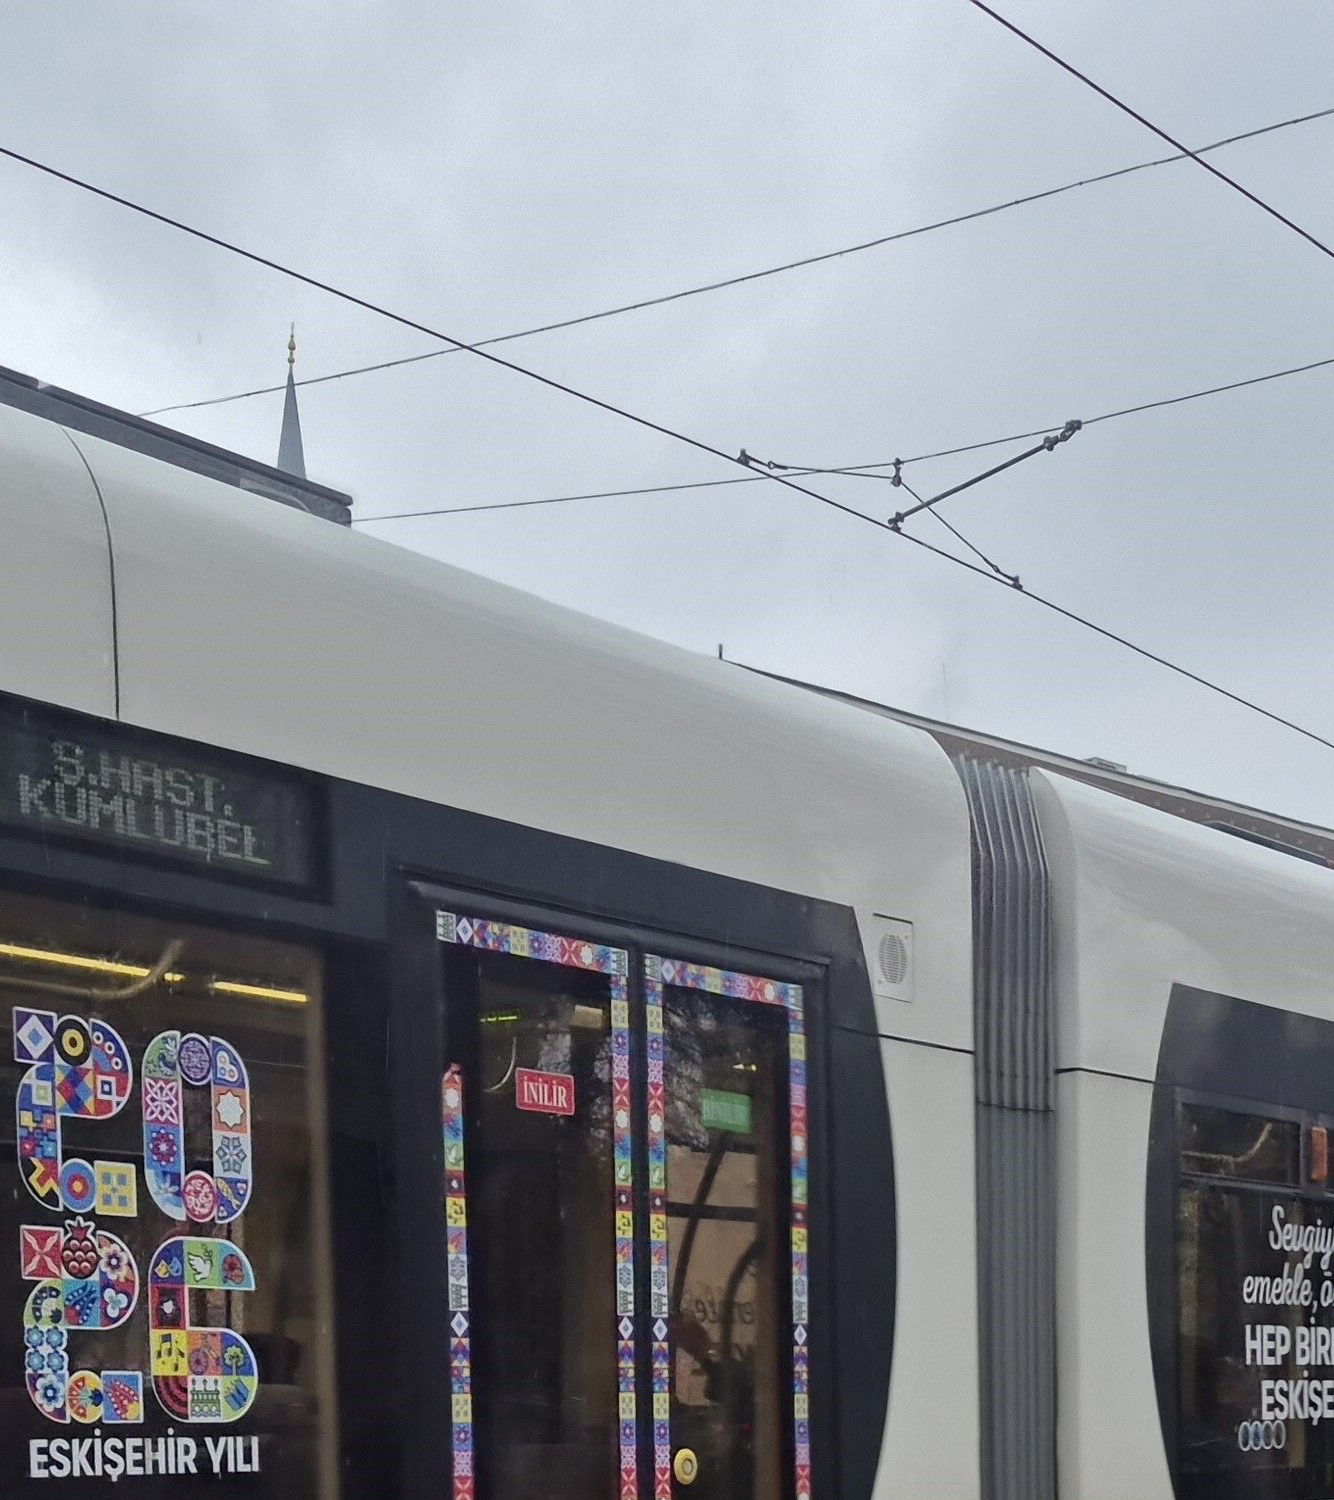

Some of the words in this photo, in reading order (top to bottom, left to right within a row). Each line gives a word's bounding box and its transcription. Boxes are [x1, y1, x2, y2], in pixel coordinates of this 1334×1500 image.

[522, 1075, 569, 1109] İNİLİR
[1242, 1262, 1318, 1314] emekle,
[1245, 1324, 1292, 1366] HEP
[29, 1427, 198, 1482] ESKİŞEHİR
[204, 1435, 260, 1474] YILI
